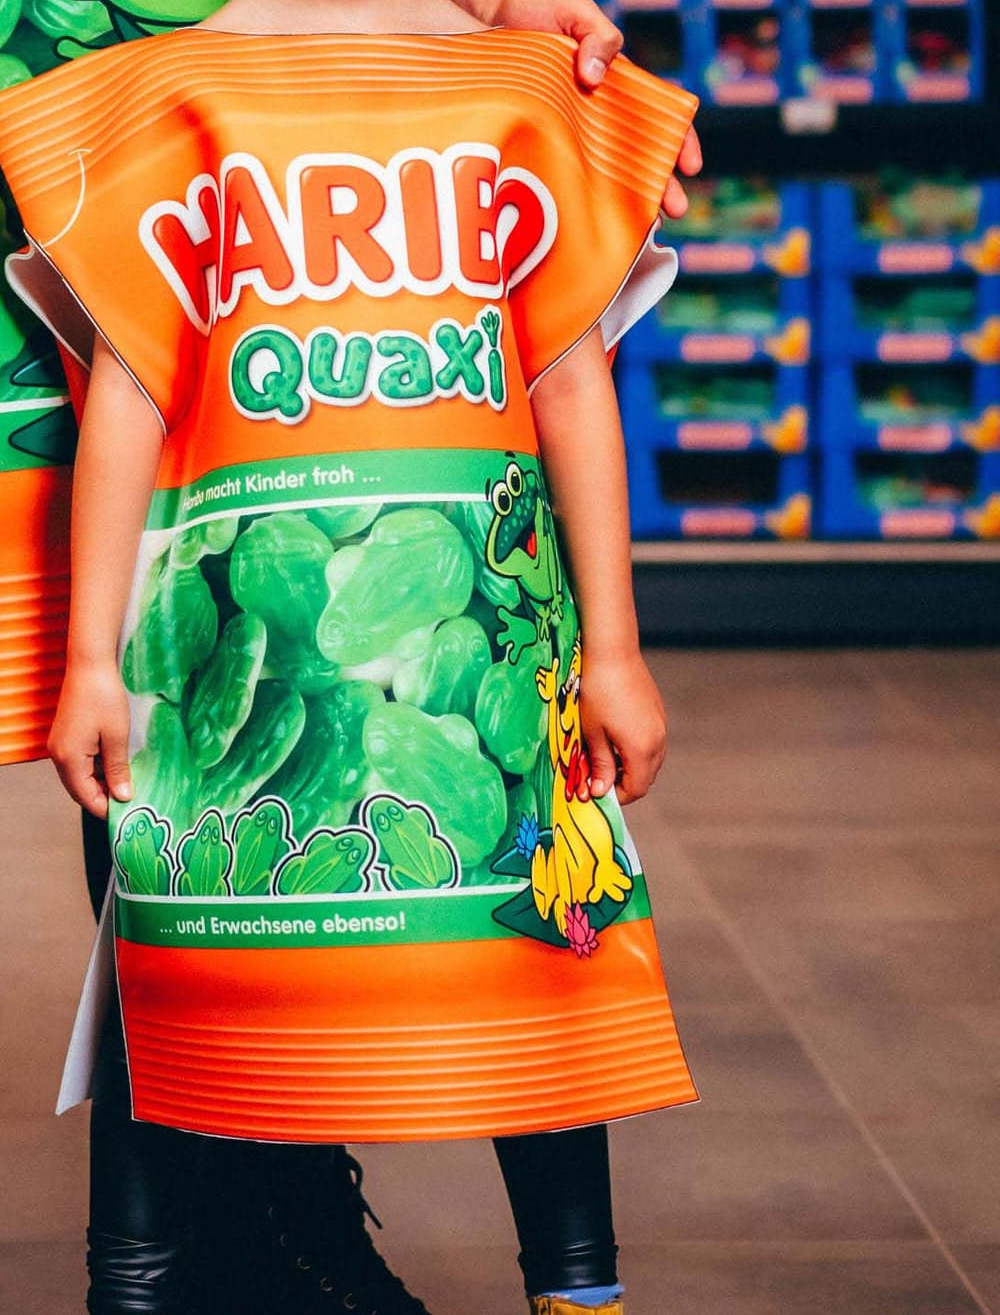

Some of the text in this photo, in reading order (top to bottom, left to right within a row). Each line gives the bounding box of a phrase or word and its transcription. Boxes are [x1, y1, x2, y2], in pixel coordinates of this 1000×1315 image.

[231, 311, 503, 418] Quaxi
[205, 477, 242, 501] macht
[245, 470, 308, 493] Kinder
[312, 464, 354, 485] froh
[176, 915, 206, 934] und
[211, 915, 316, 934] Erwachsene
[323, 912, 406, 933] ebenso!
